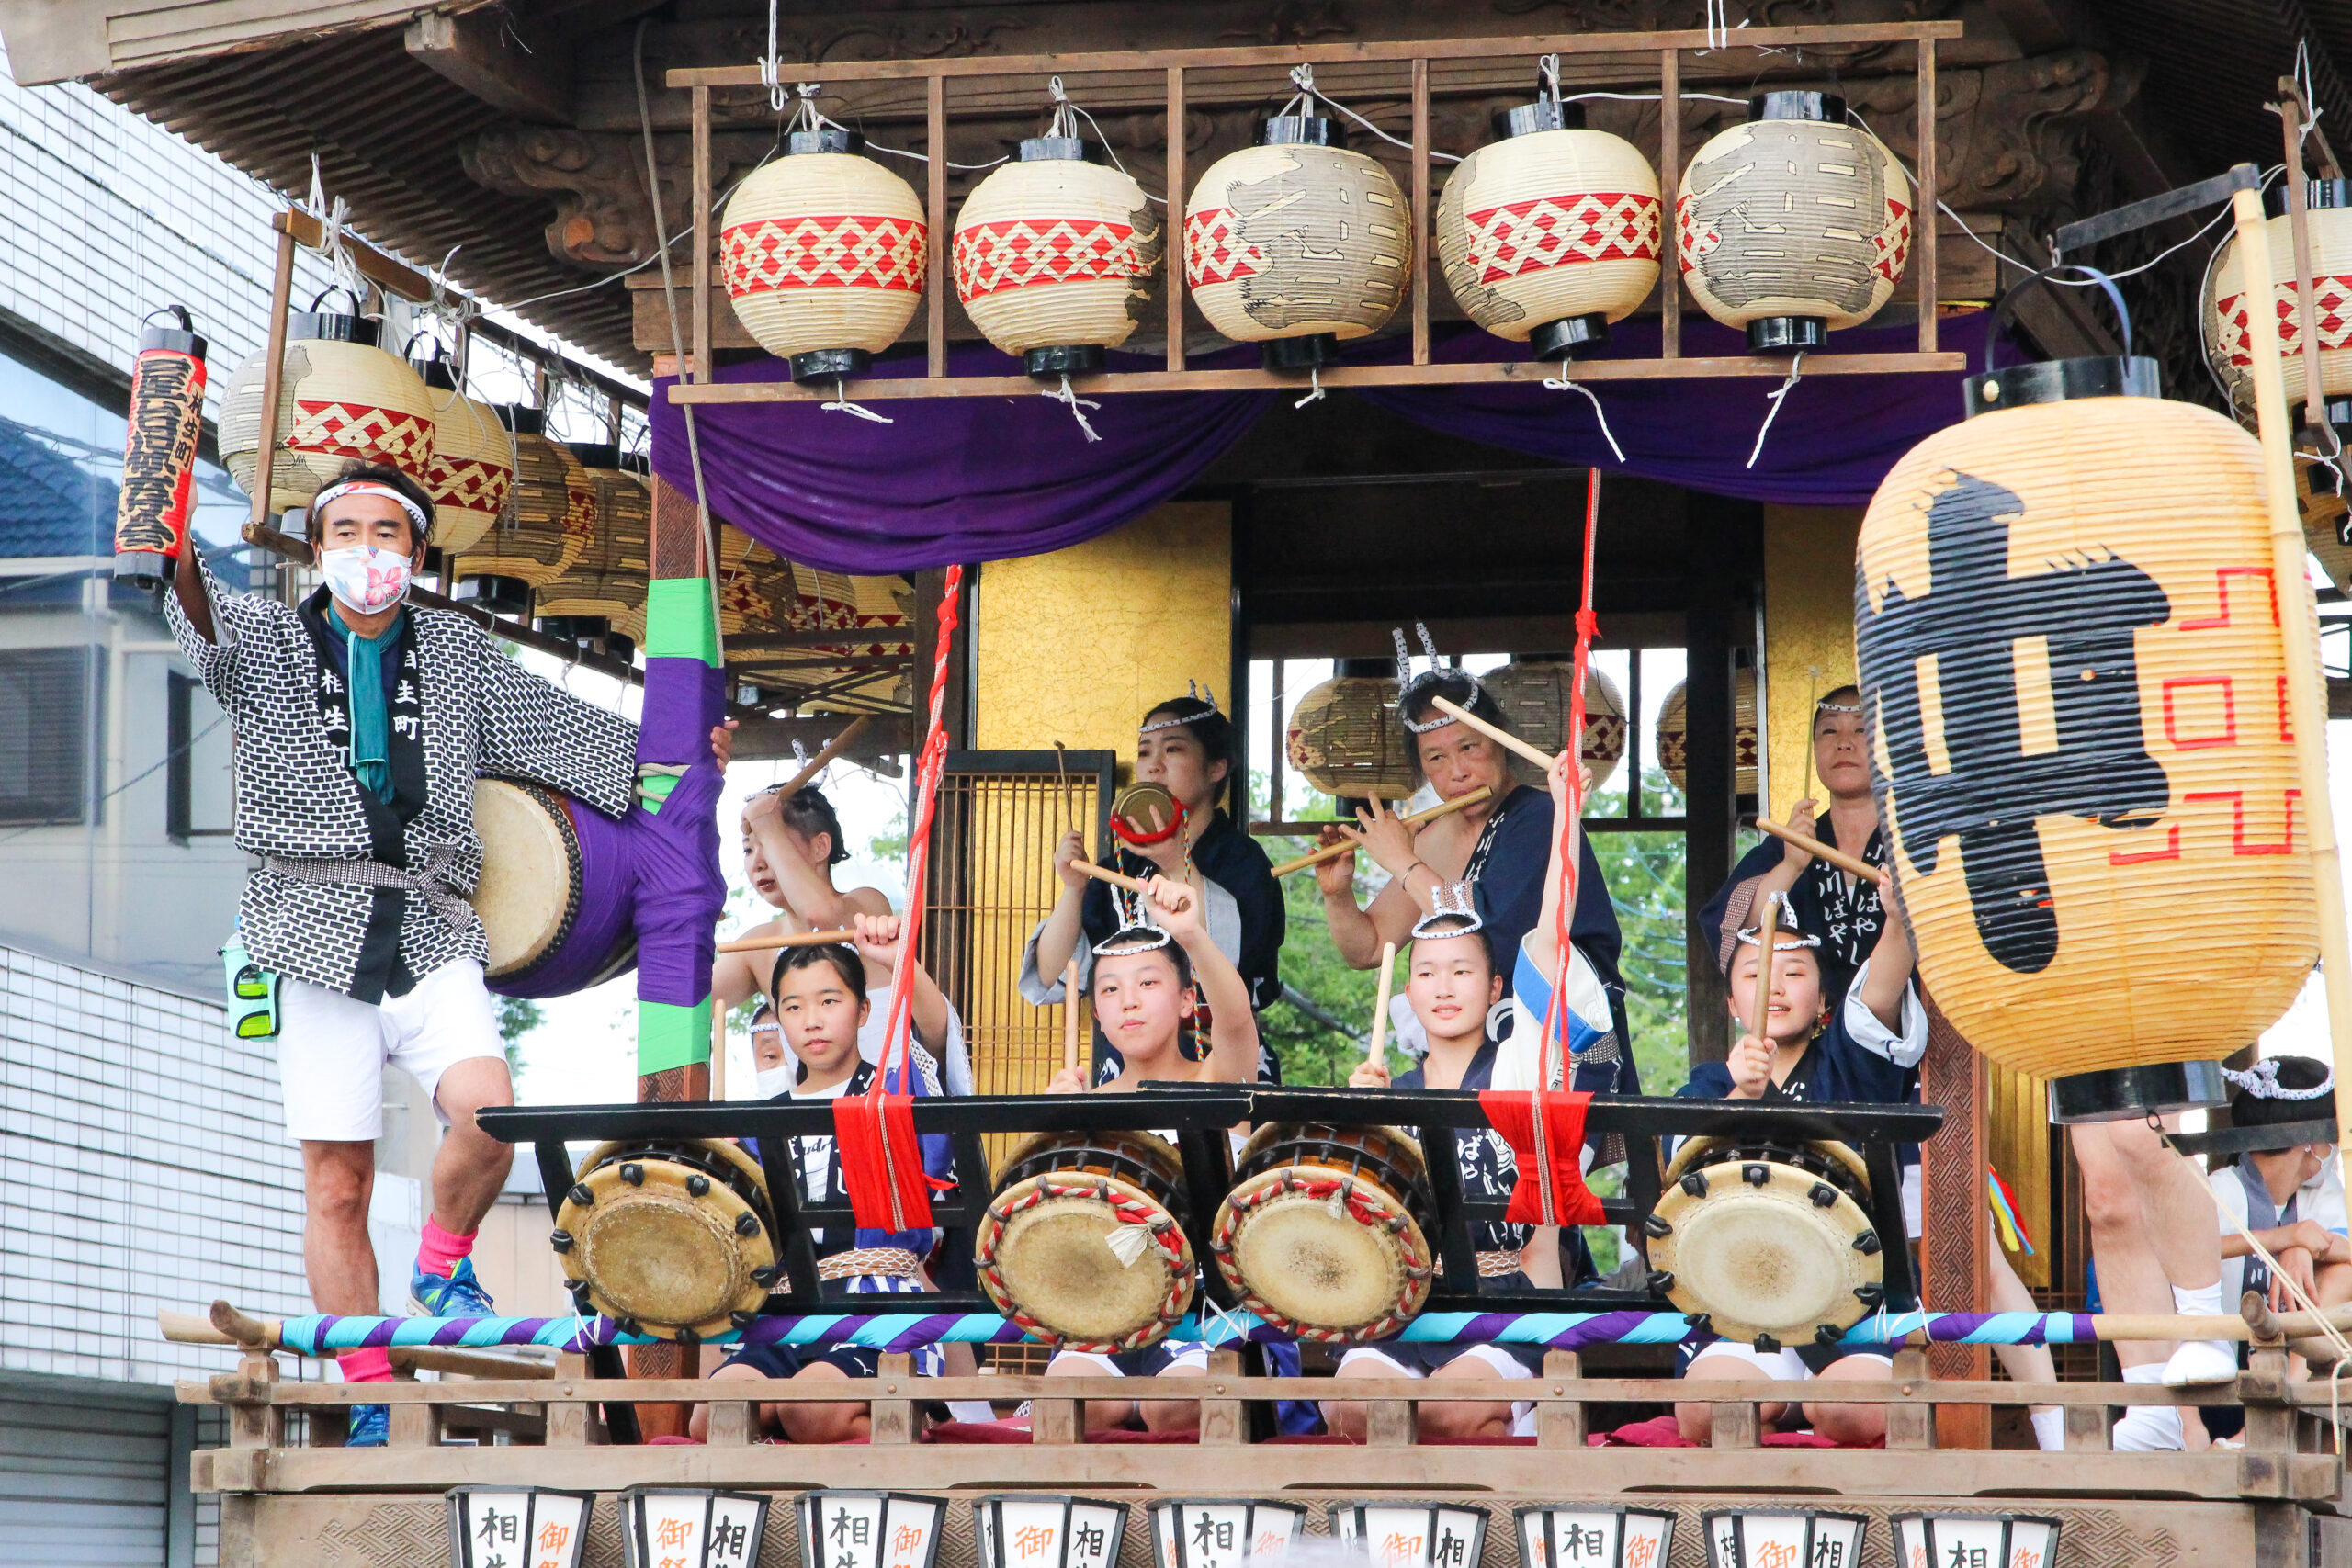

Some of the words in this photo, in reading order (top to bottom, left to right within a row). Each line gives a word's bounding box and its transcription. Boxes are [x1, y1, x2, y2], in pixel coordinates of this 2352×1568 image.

[537, 1521, 570, 1568] 御
[708, 1515, 746, 1568] 相
[892, 1524, 922, 1568] 御
[1072, 1521, 1105, 1568] 相
[1193, 1512, 1234, 1568] 相
[1559, 1523, 1604, 1562] 相
